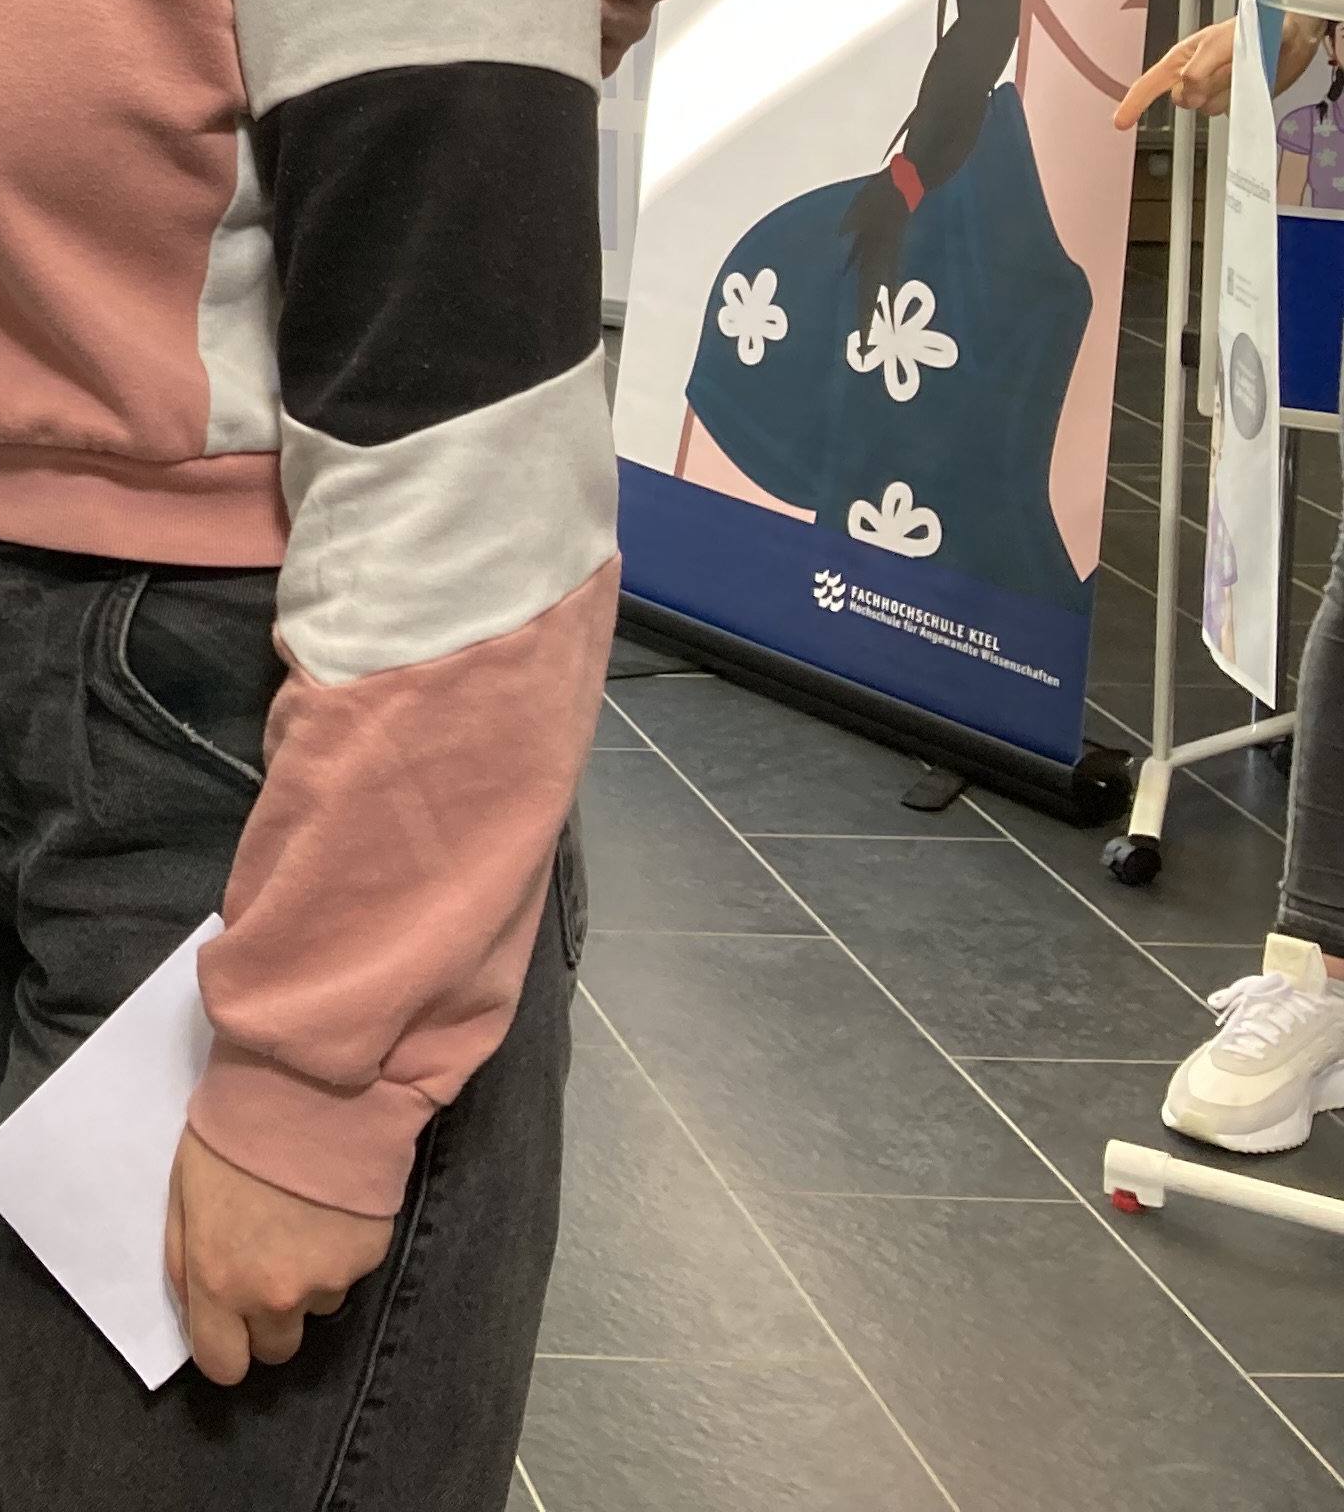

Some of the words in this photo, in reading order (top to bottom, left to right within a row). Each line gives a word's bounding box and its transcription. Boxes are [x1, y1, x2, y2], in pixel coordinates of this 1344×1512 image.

[849, 600, 901, 629] Hochschule
[903, 618, 918, 634] für
[919, 626, 979, 658] Angewandte
[980, 648, 1060, 688] Wissenschaften
[851, 585, 965, 638] FACHHOCHSCHULE
[968, 628, 1000, 651] KIEL
